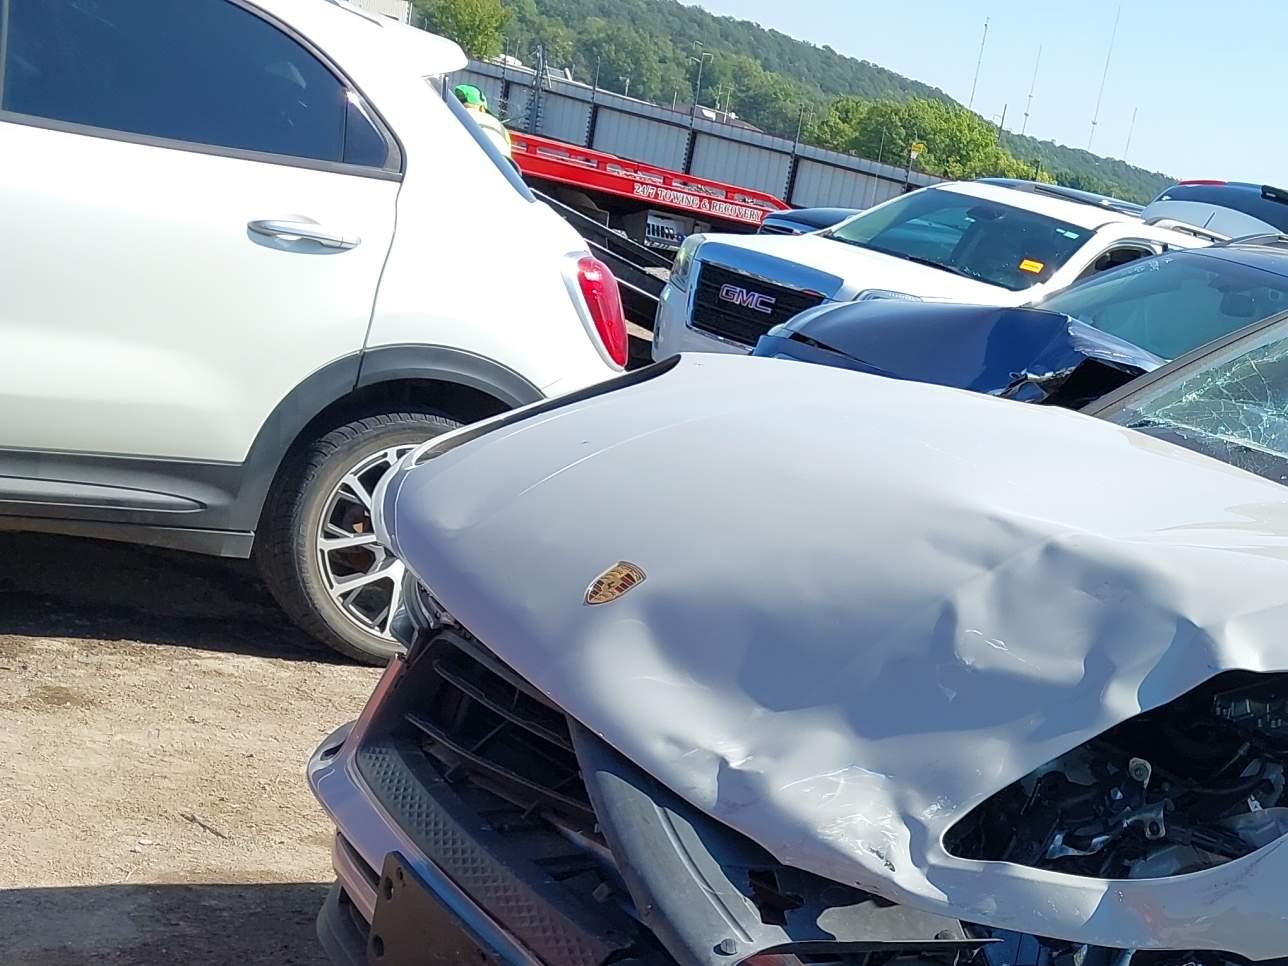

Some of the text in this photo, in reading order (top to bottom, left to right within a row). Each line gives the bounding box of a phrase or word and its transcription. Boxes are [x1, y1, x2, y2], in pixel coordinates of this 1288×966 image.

[634, 183, 763, 222] 24/7 TOWING & RECOVERY
[719, 283, 776, 314] GMC
